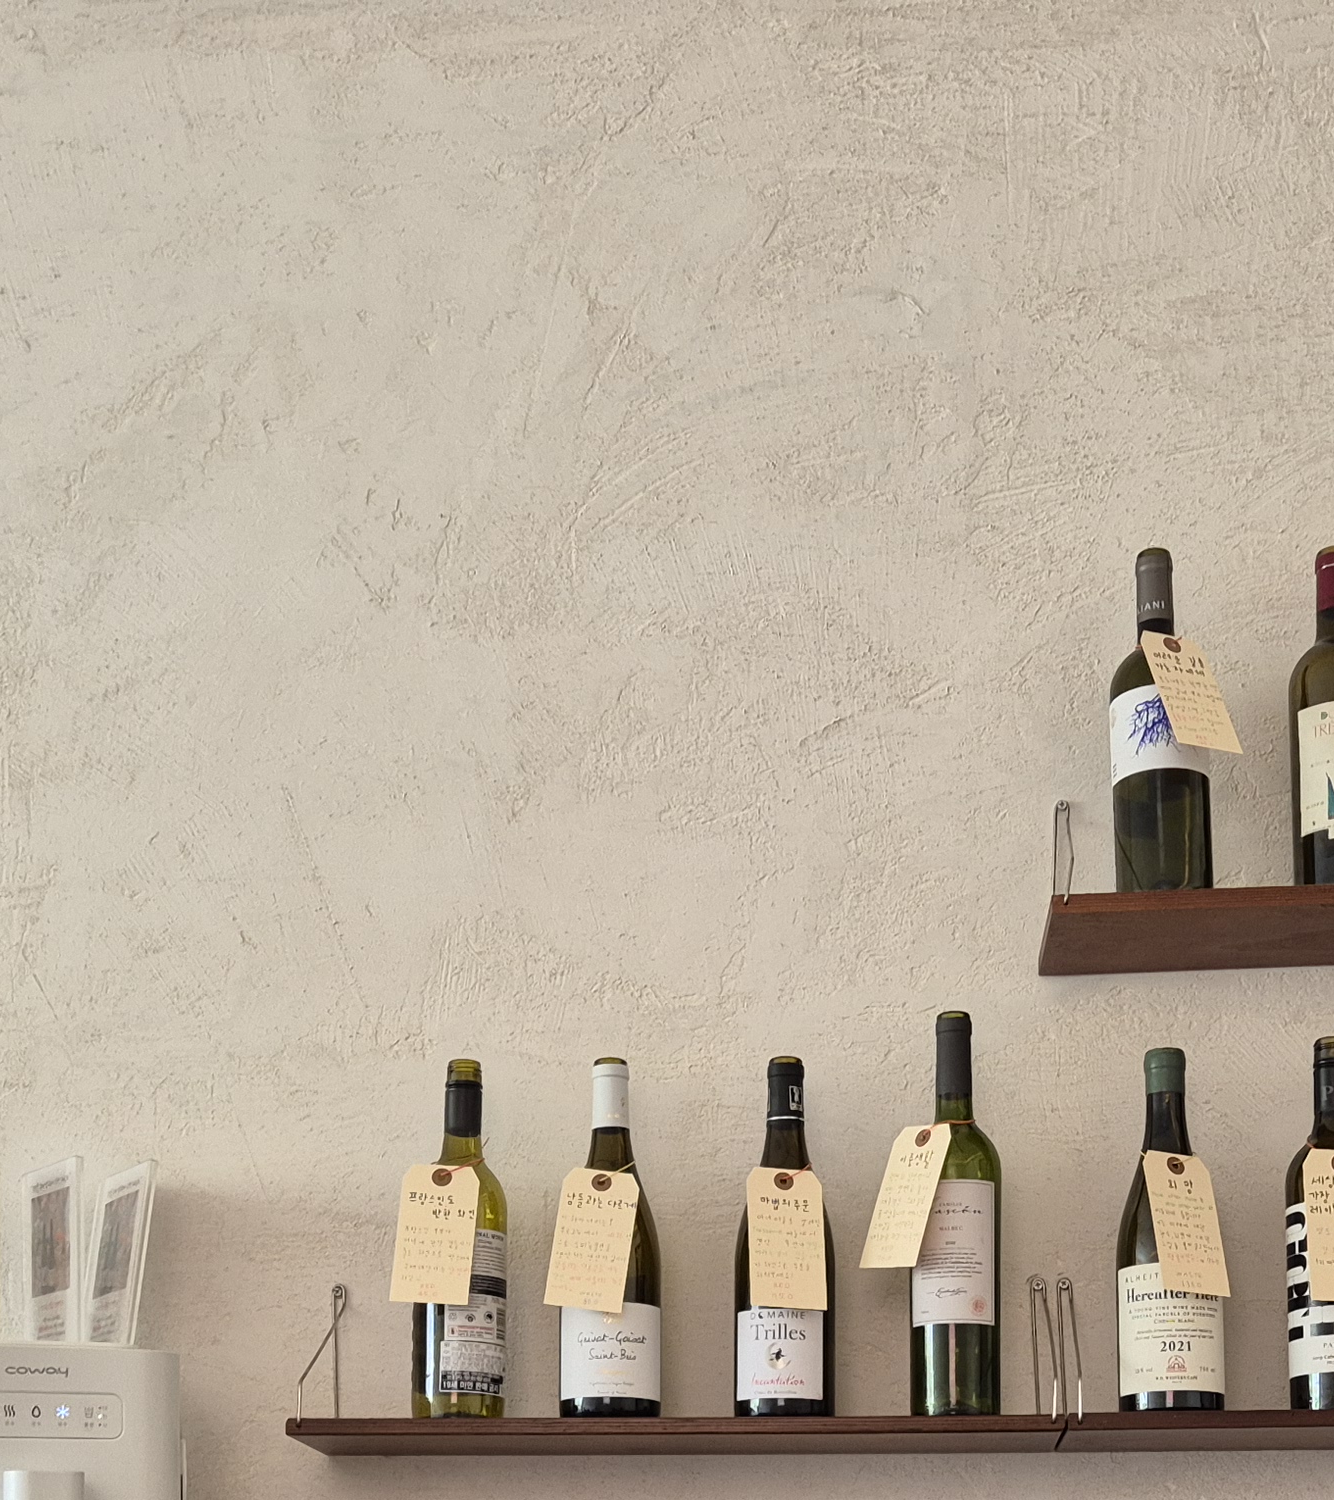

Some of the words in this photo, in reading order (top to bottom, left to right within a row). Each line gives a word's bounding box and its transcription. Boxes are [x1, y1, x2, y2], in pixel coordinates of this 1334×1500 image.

[567, 1192, 603, 1209] 남들과는
[1309, 1190, 1330, 1203] 가장
[1125, 1272, 1159, 1284] ALHEIT
[750, 1322, 806, 1340] Trilles
[1160, 1340, 1192, 1352] 2021
[4, 1366, 69, 1378] coway
[442, 1381, 458, 1390] 19세
[459, 1381, 474, 1390] 미만
[751, 1373, 805, 1386] Incantation
